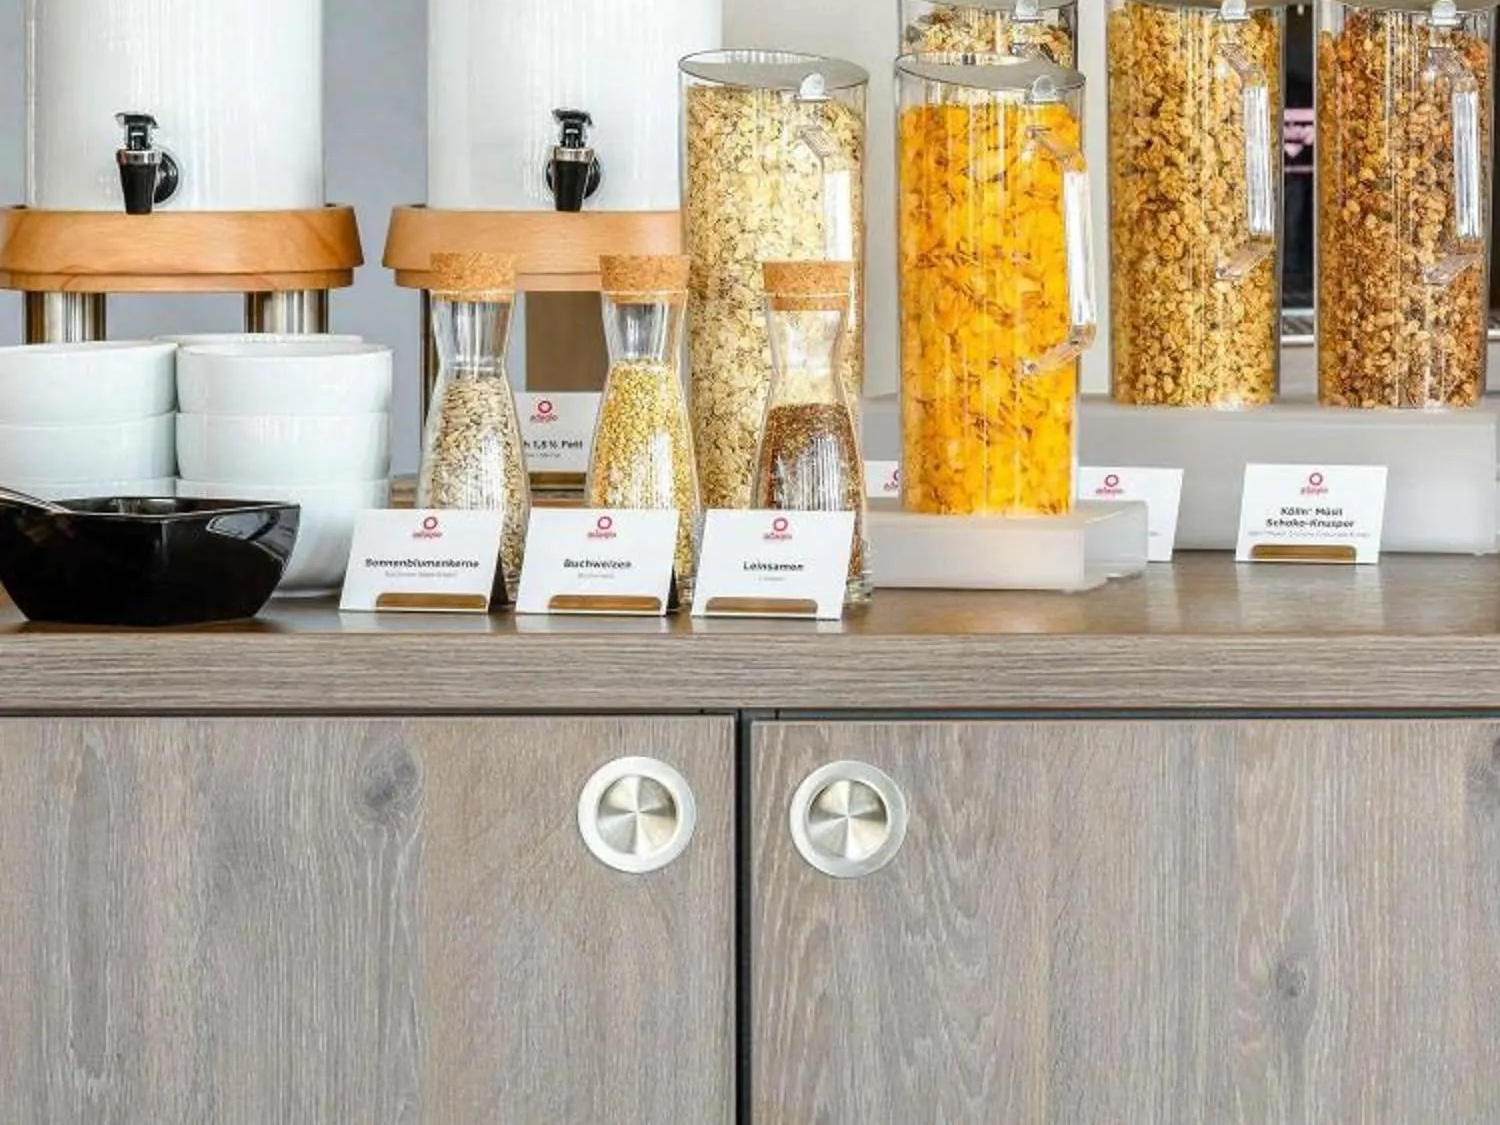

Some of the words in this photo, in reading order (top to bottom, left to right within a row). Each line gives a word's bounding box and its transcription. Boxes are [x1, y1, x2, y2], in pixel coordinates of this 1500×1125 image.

[561, 440, 583, 448] Fett
[1266, 518, 1355, 529] Schoko-Knusper
[365, 558, 480, 568] Sonnenblumenkerne
[563, 558, 632, 568] Buchweizen
[743, 561, 804, 571] Leinsamen
